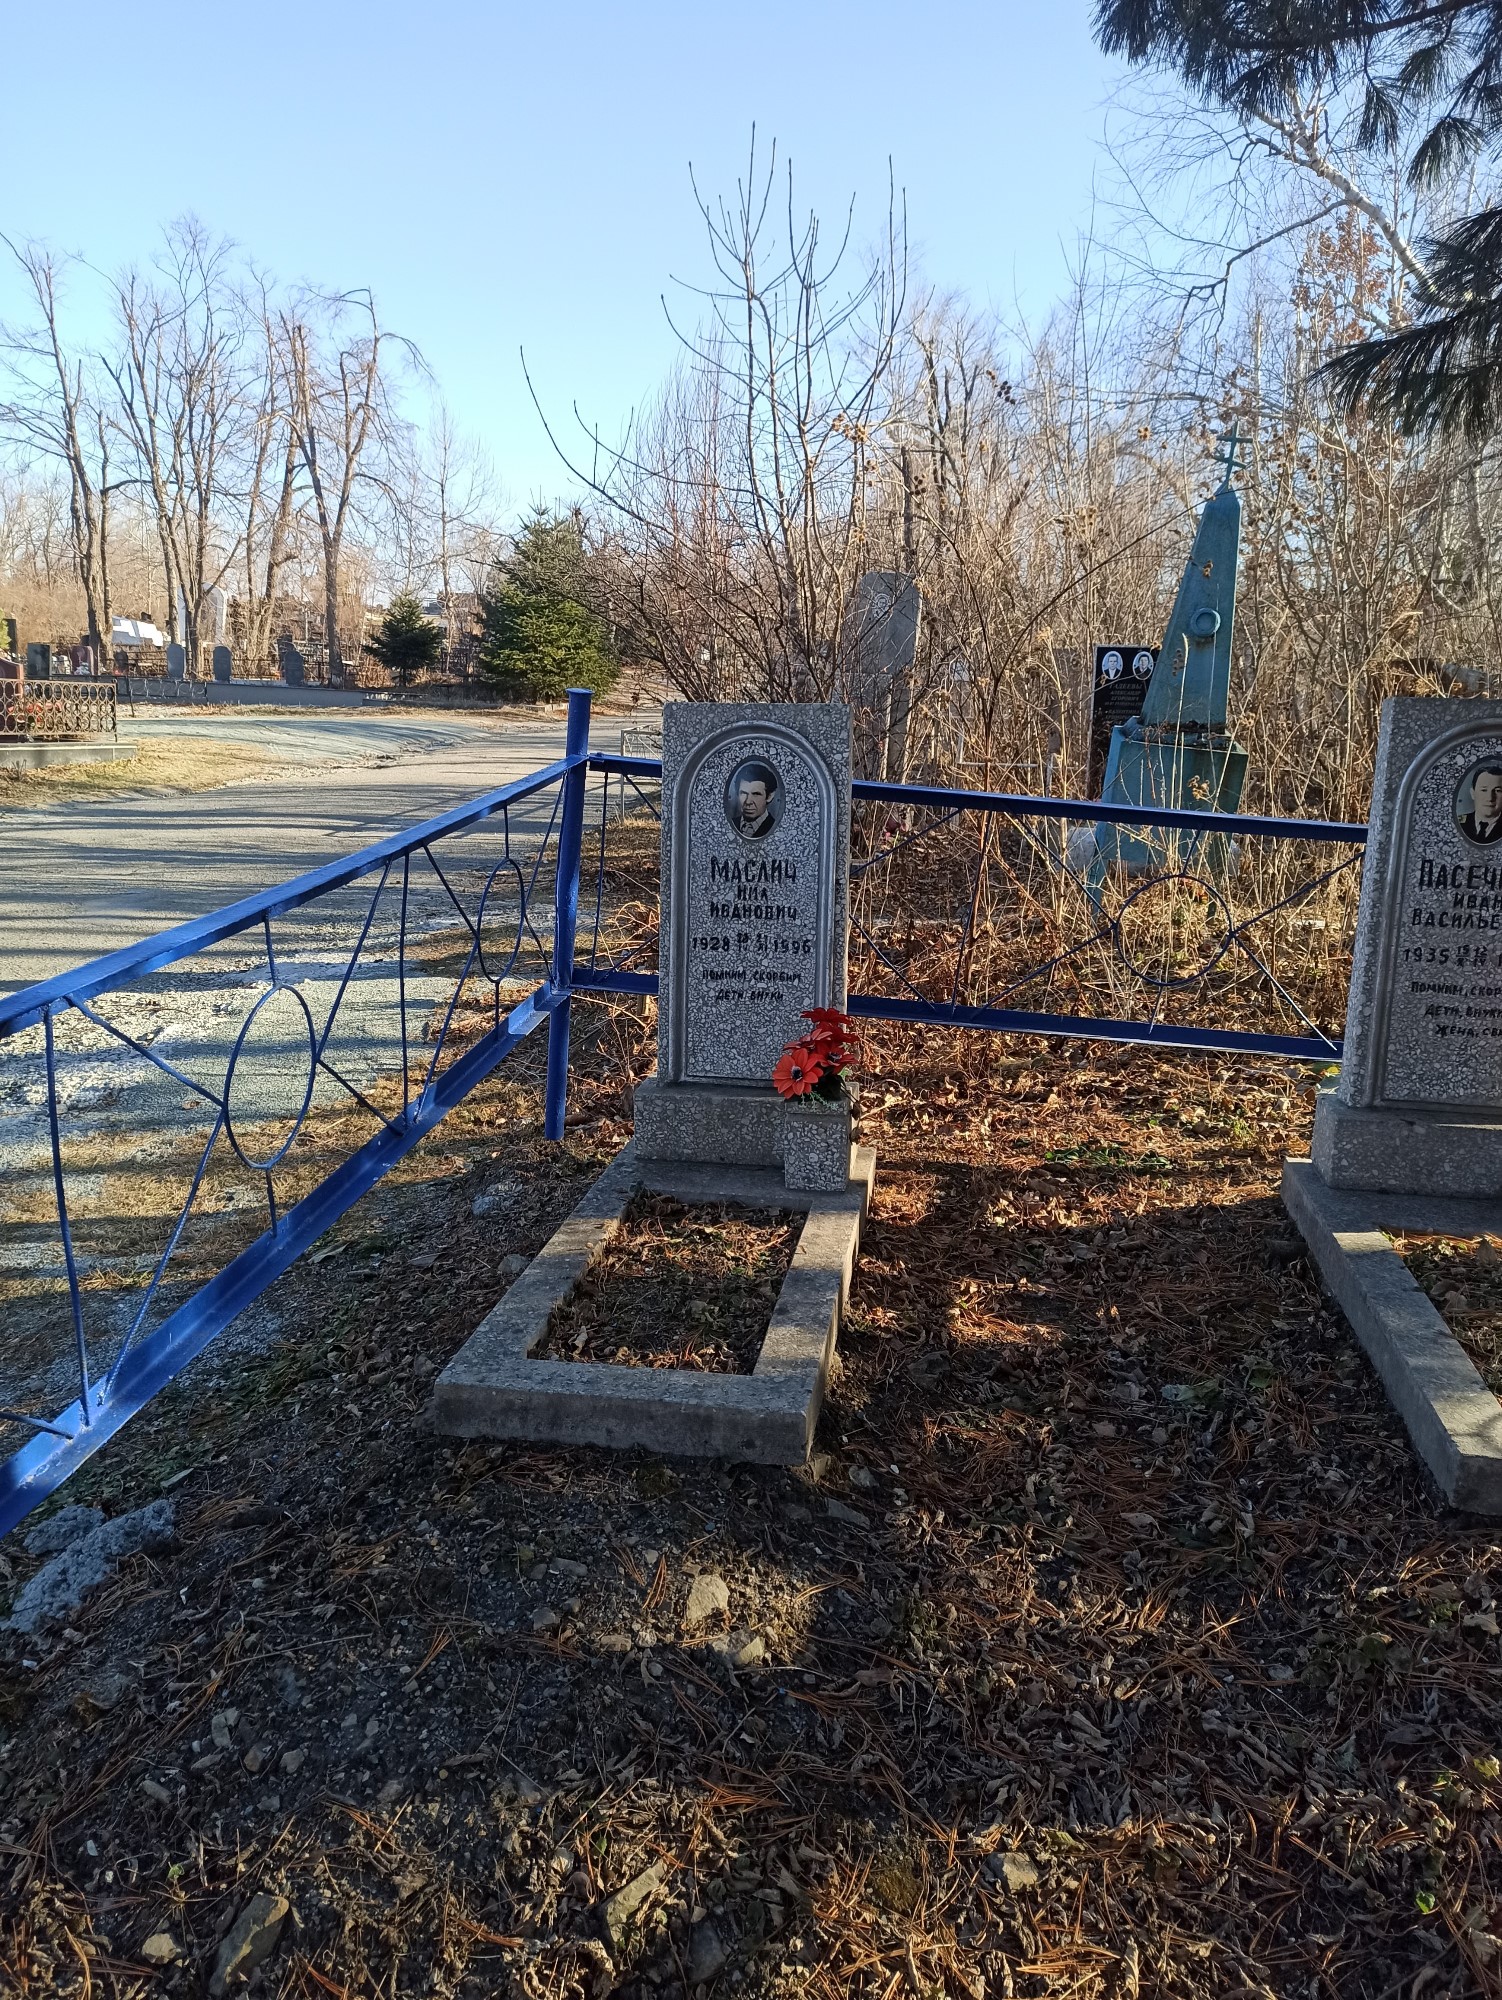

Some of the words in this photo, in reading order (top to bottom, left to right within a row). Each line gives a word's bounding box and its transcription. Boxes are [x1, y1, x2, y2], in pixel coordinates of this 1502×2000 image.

[1419, 860, 1502, 891] ПАСЕЧ
[710, 903, 797, 921] ИВАНОВИЧ
[1403, 947, 1450, 965] 1935
[702, 970, 746, 980] ПОМНИМ
